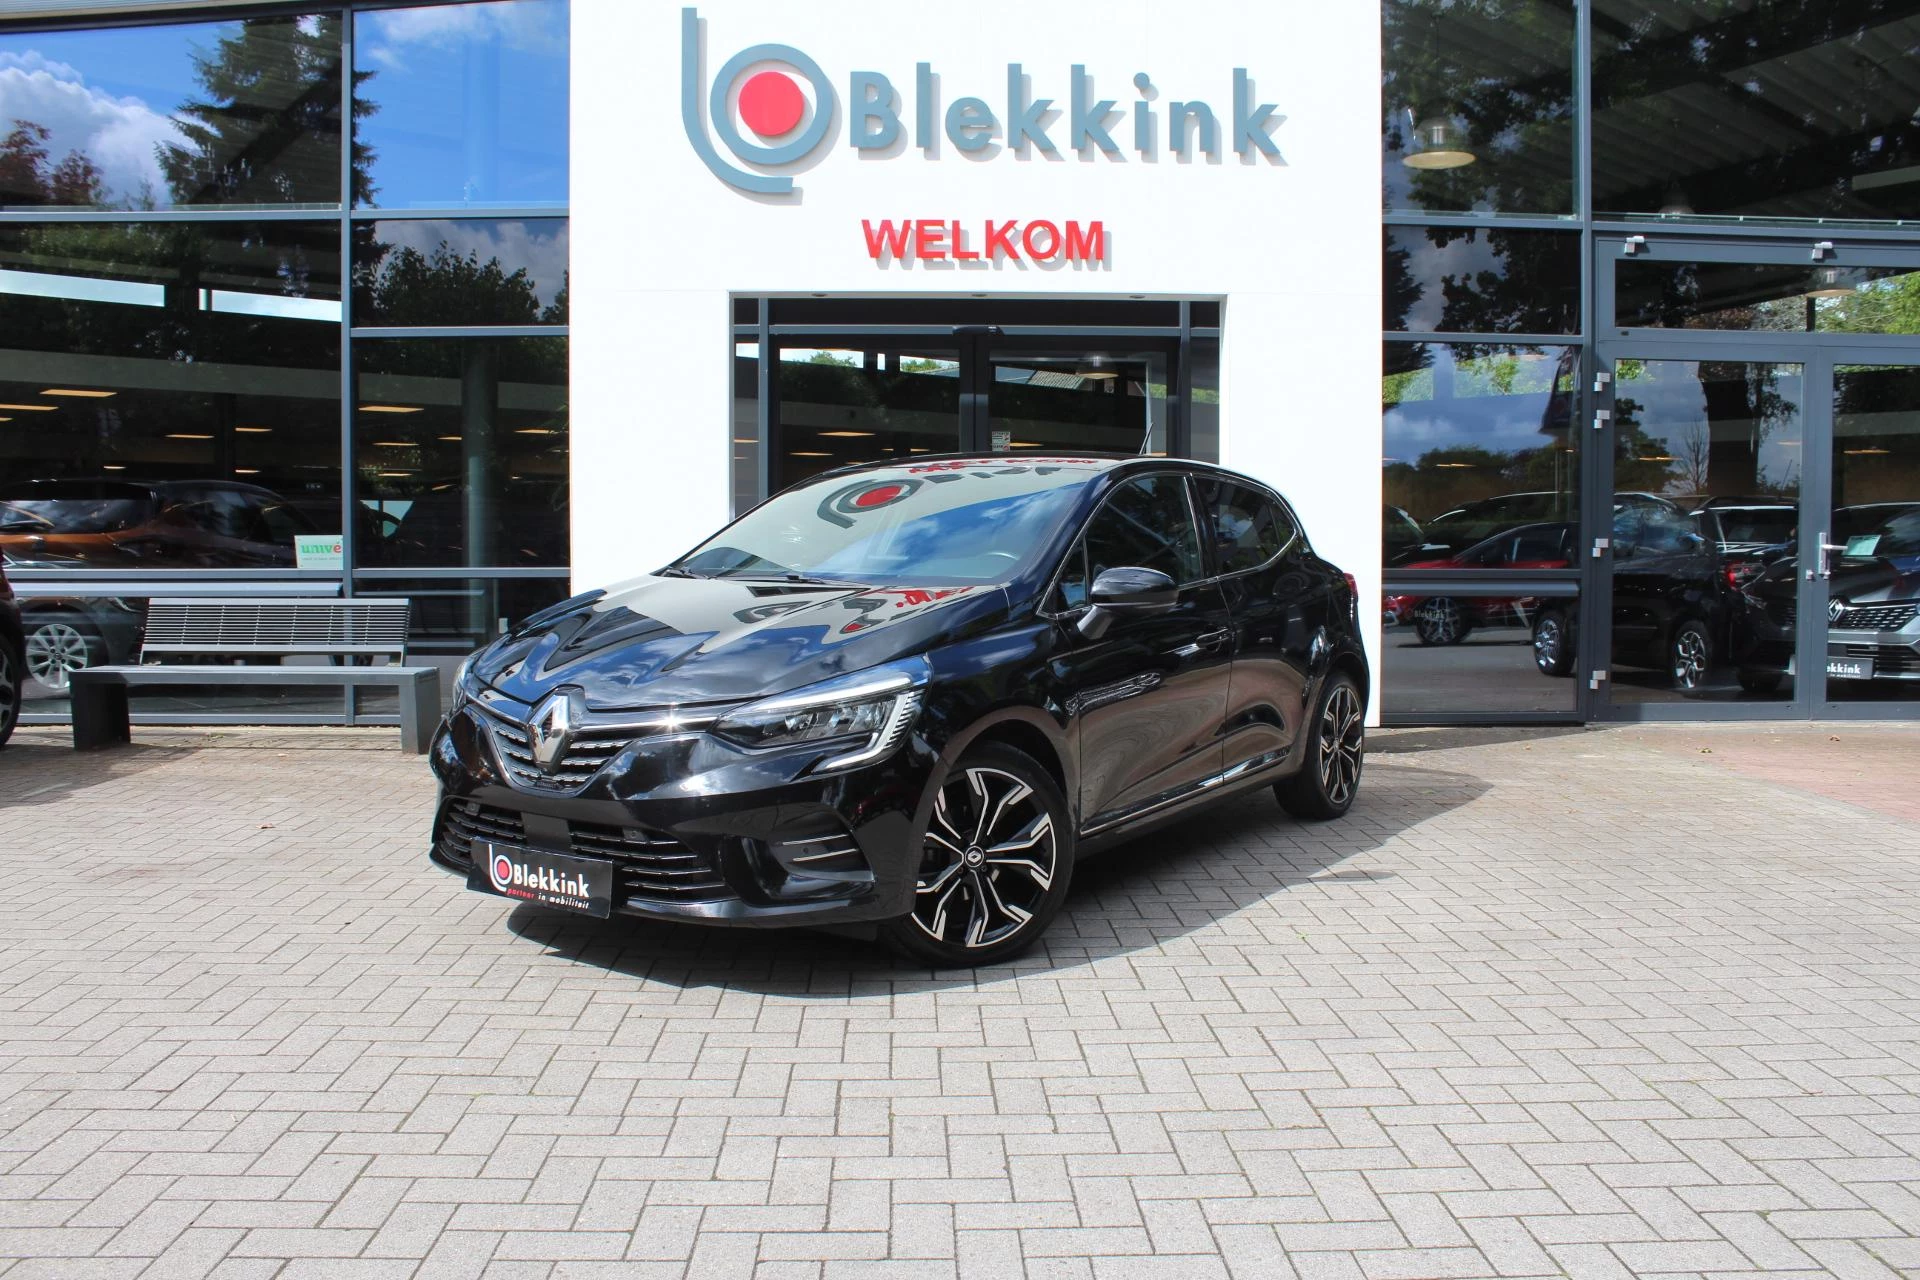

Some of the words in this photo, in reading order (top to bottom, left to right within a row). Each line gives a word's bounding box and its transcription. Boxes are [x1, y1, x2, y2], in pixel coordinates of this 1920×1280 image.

[850, 63, 1281, 156] Blekkink
[861, 219, 1104, 260] WELKOM
[507, 888, 535, 899] partner
[549, 896, 590, 909] mobiliteit
[513, 864, 590, 898] Blekkink
